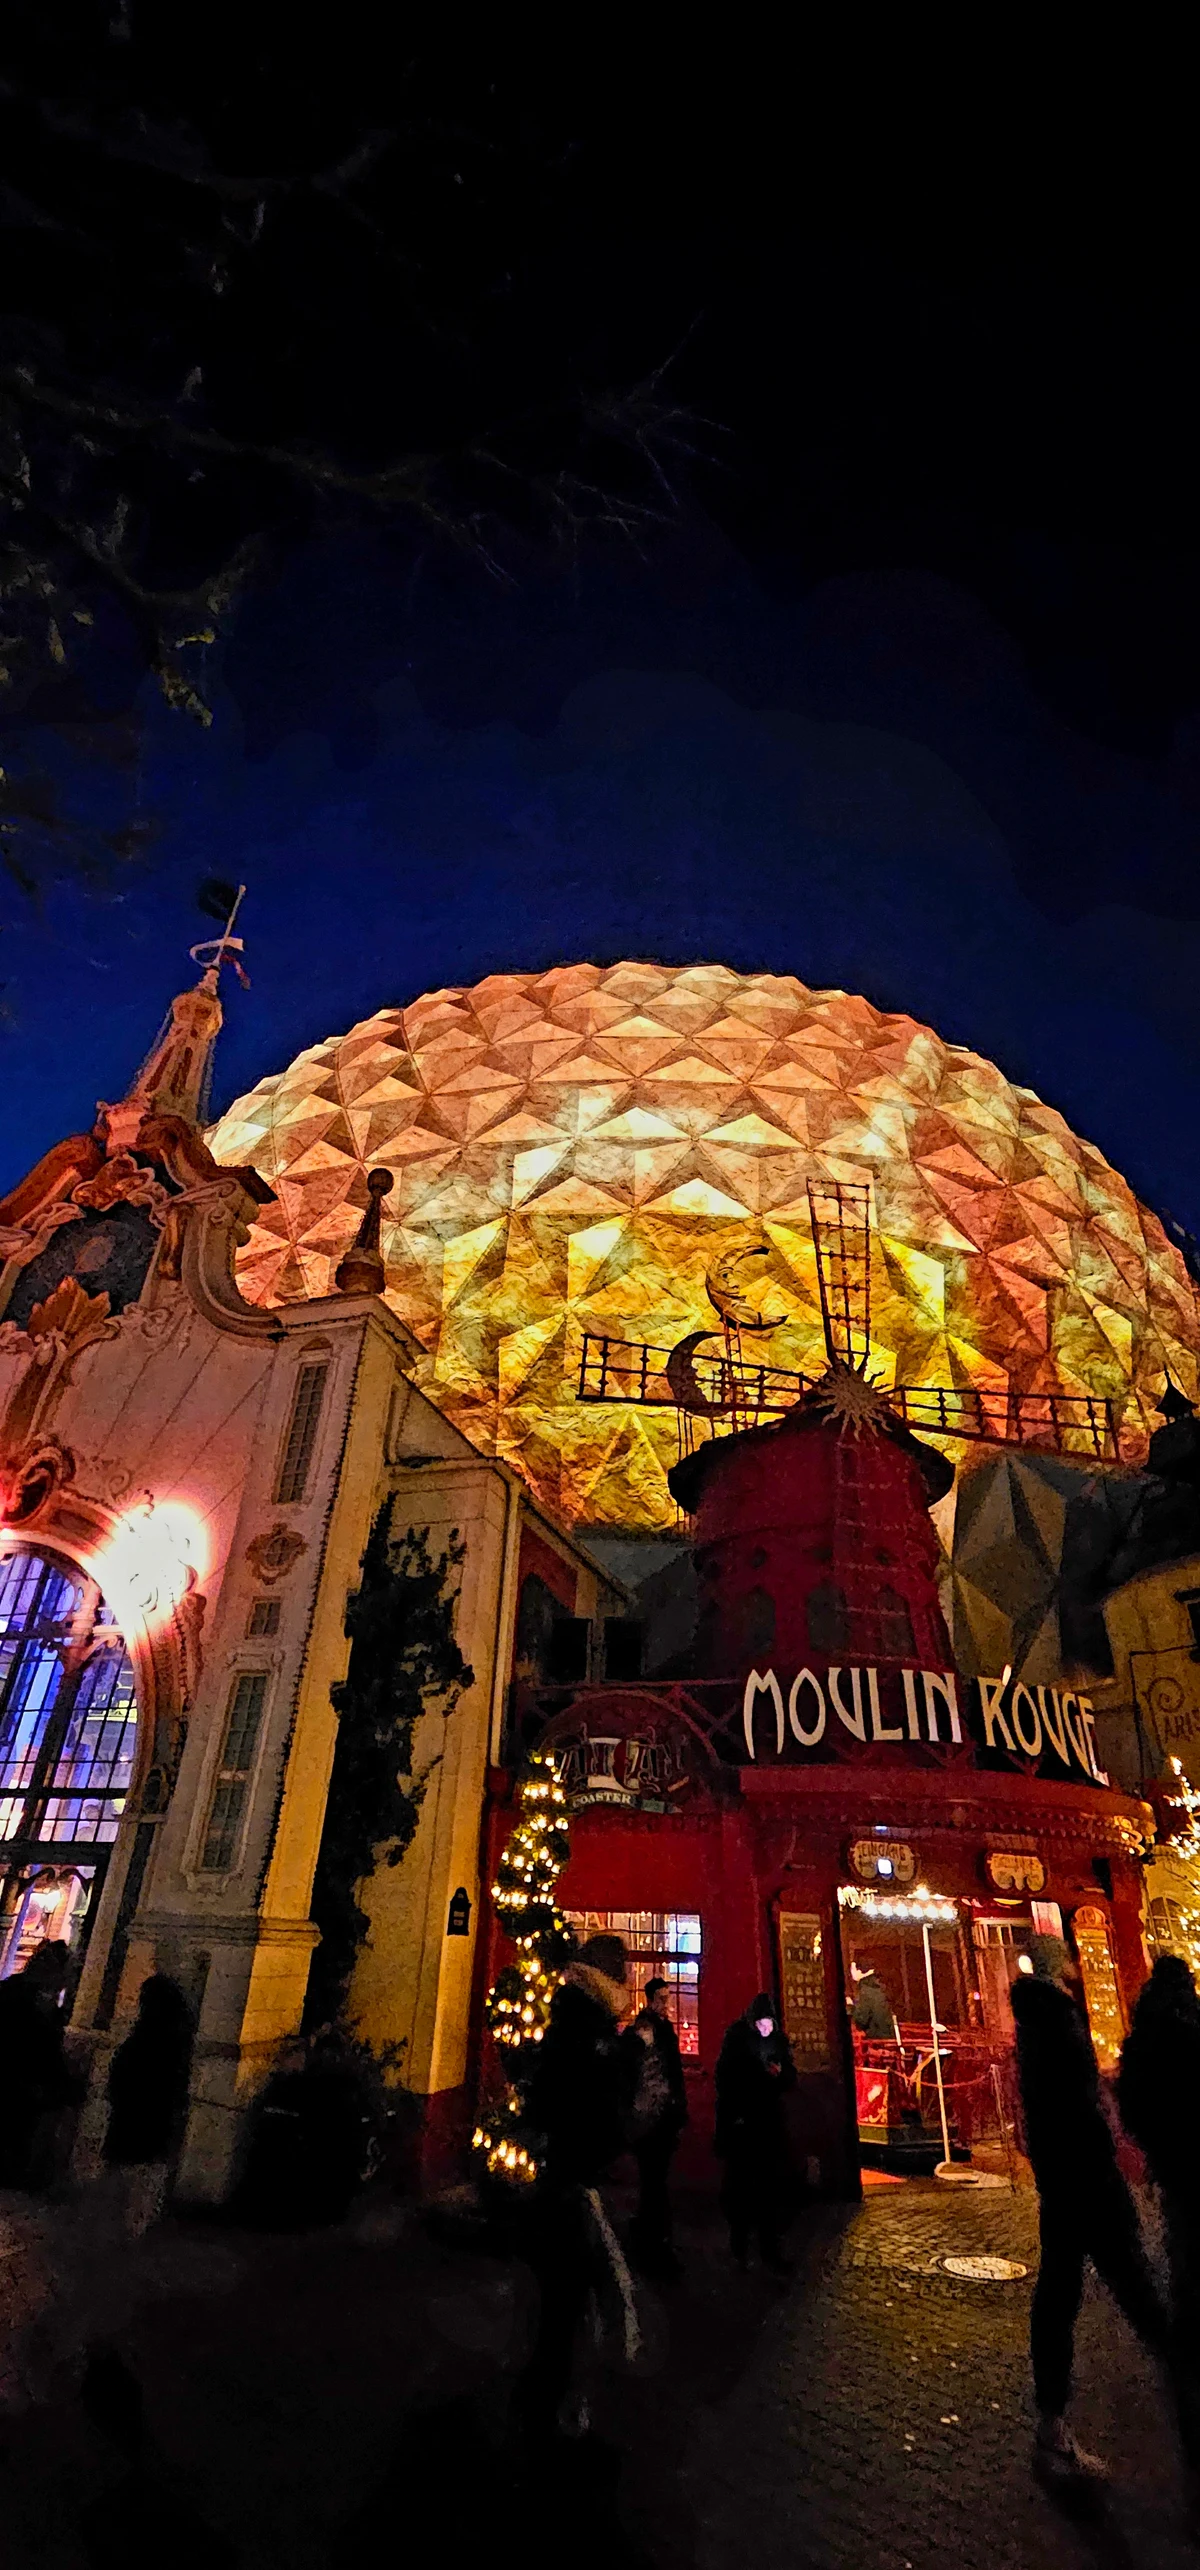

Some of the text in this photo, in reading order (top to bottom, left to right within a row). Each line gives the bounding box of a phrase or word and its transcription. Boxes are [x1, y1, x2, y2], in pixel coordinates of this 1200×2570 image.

[743, 1667, 1110, 1787] MOULIN ROUGE
[572, 1791, 632, 1809] COASTER
